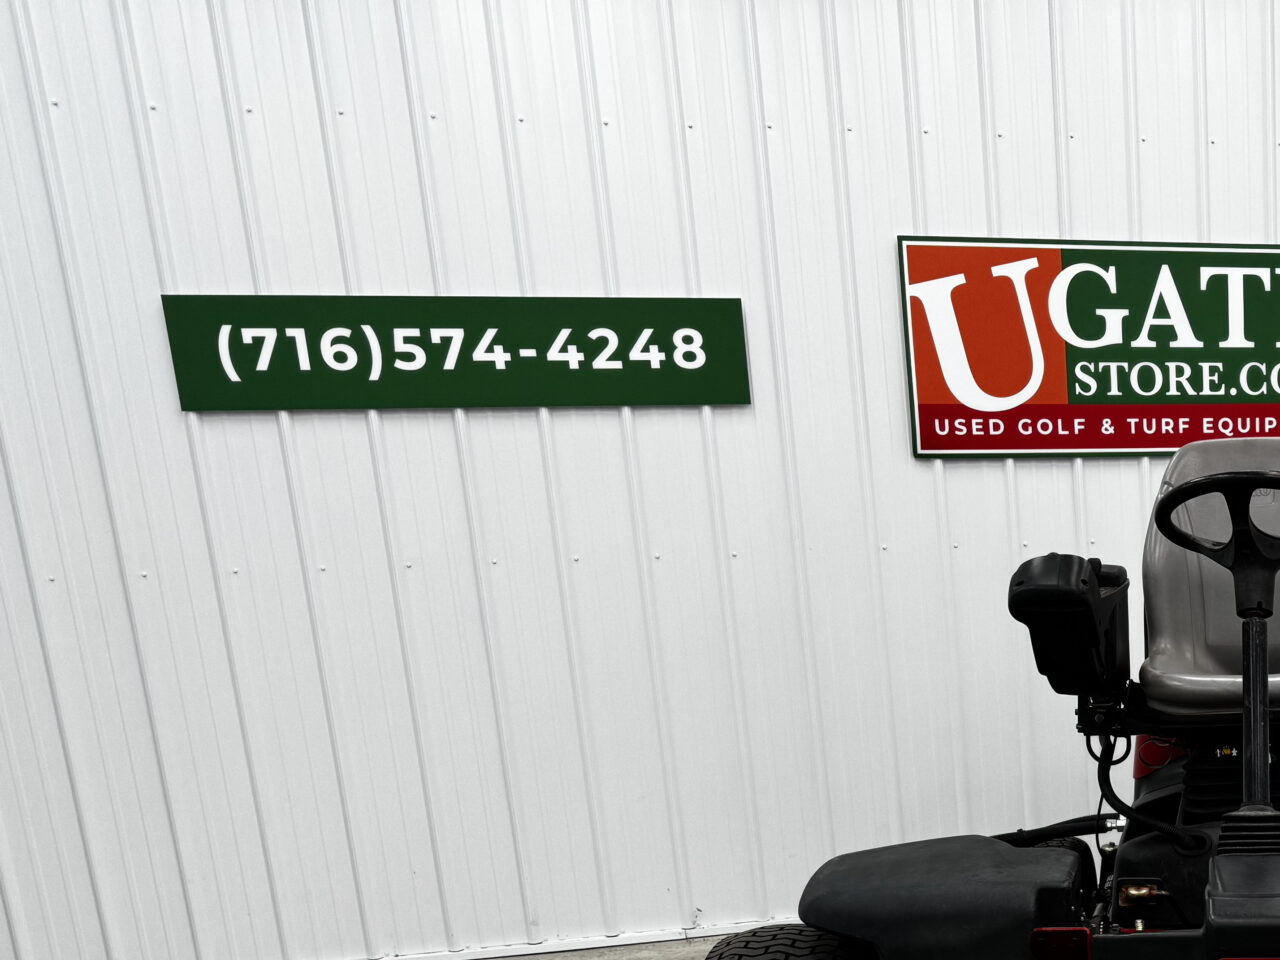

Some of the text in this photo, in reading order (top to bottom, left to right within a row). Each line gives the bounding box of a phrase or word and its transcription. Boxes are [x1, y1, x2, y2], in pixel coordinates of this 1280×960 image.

[217, 324, 707, 382] (716)574-4248
[935, 418, 1005, 436] USED
[1018, 418, 1086, 436] GOLF
[1101, 418, 1115, 435] &
[1127, 417, 1190, 435] TURF
